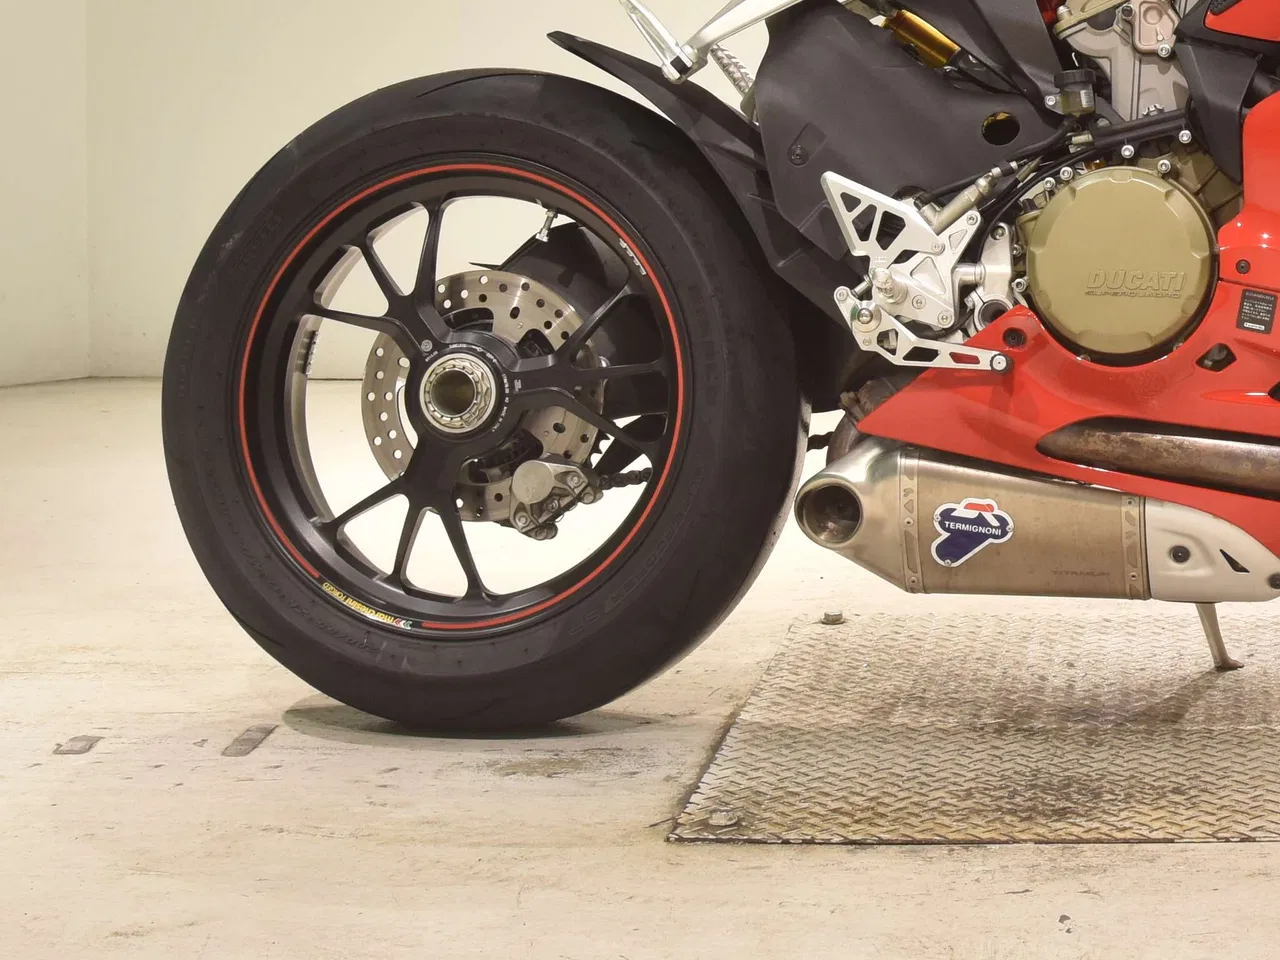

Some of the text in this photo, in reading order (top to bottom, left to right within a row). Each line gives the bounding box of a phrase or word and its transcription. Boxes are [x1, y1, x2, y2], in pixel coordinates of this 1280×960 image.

[1086, 269, 1187, 291] DUCATI
[944, 521, 1002, 536] TERMIGNONI
[345, 597, 395, 624] marchesini
